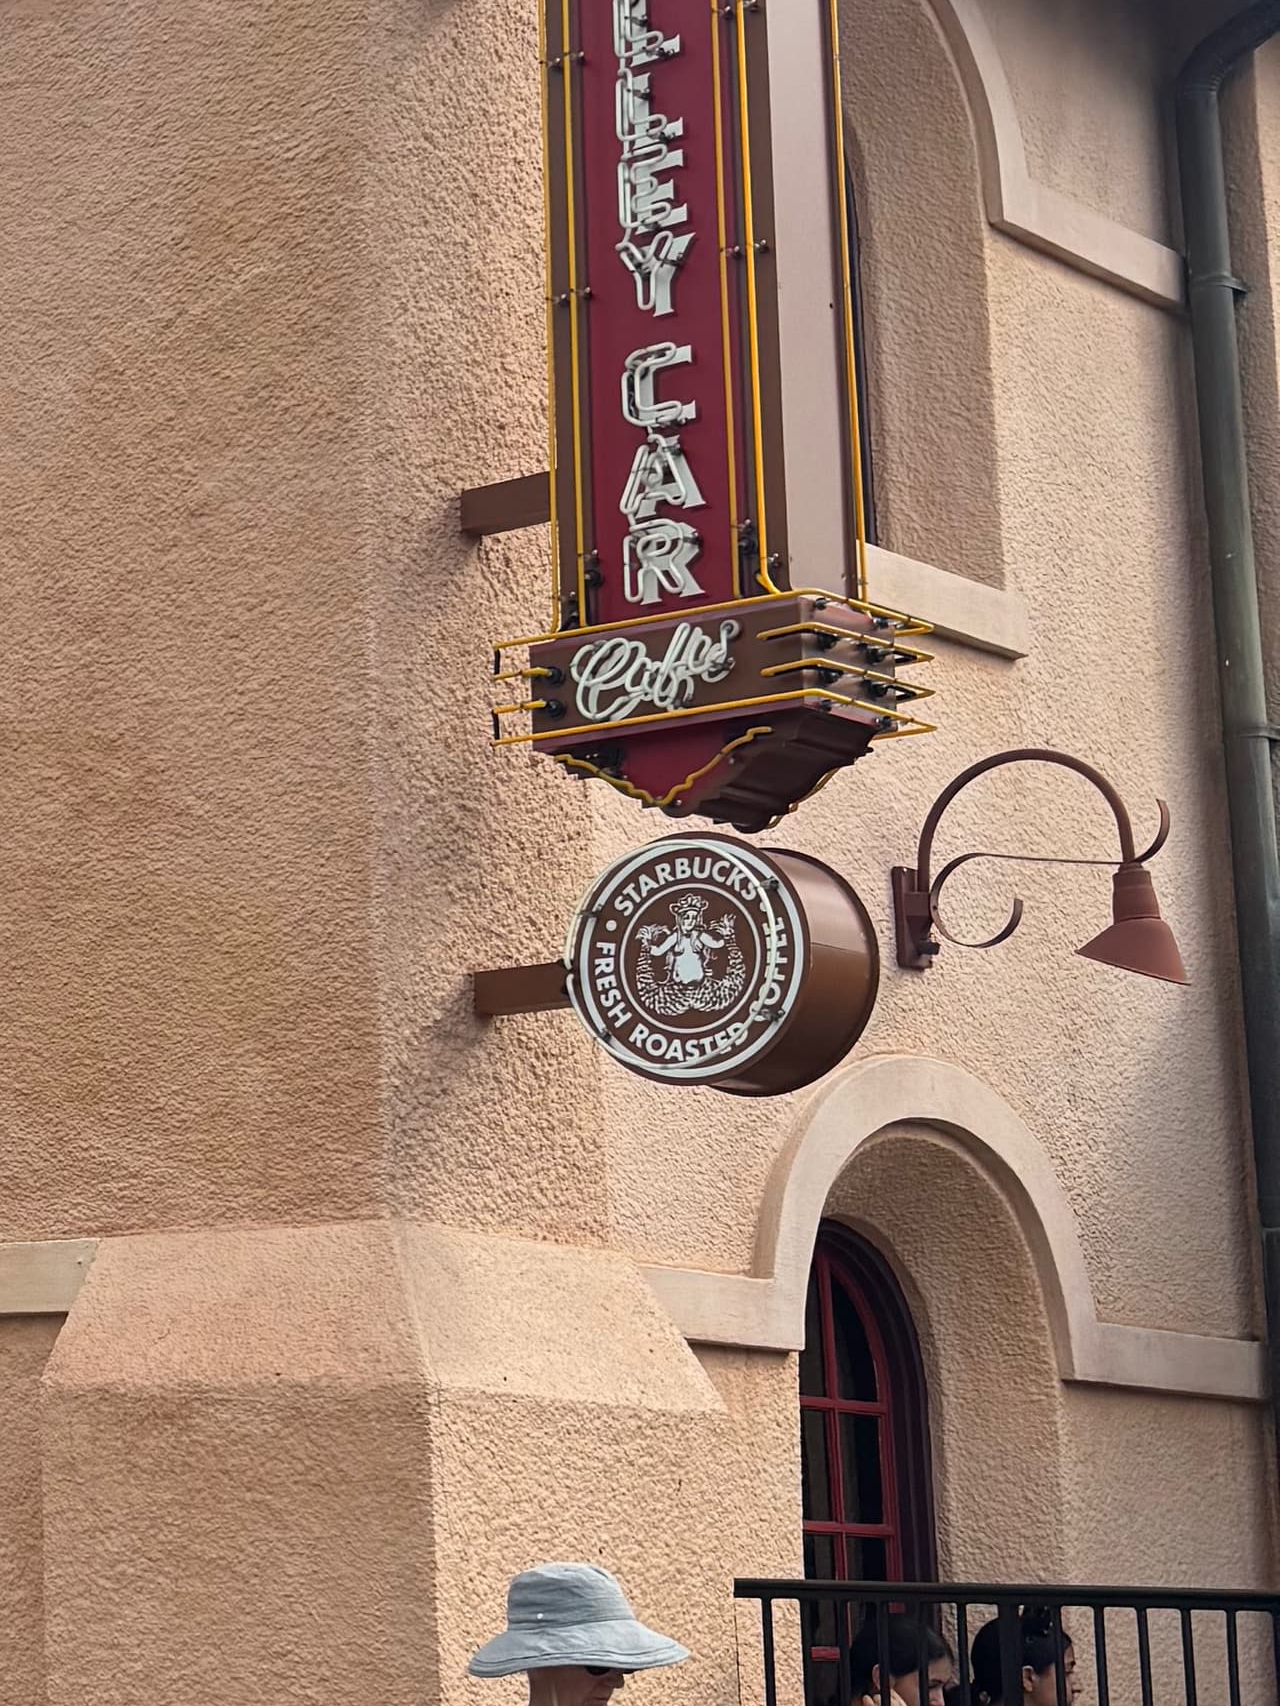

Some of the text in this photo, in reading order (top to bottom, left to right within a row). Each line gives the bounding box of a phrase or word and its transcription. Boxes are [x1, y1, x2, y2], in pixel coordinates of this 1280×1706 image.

[619, 340, 706, 605] CAR
[614, 856, 760, 917] STARBUCKS
[593, 915, 791, 1065] FRESH ROASTED COFFEE
